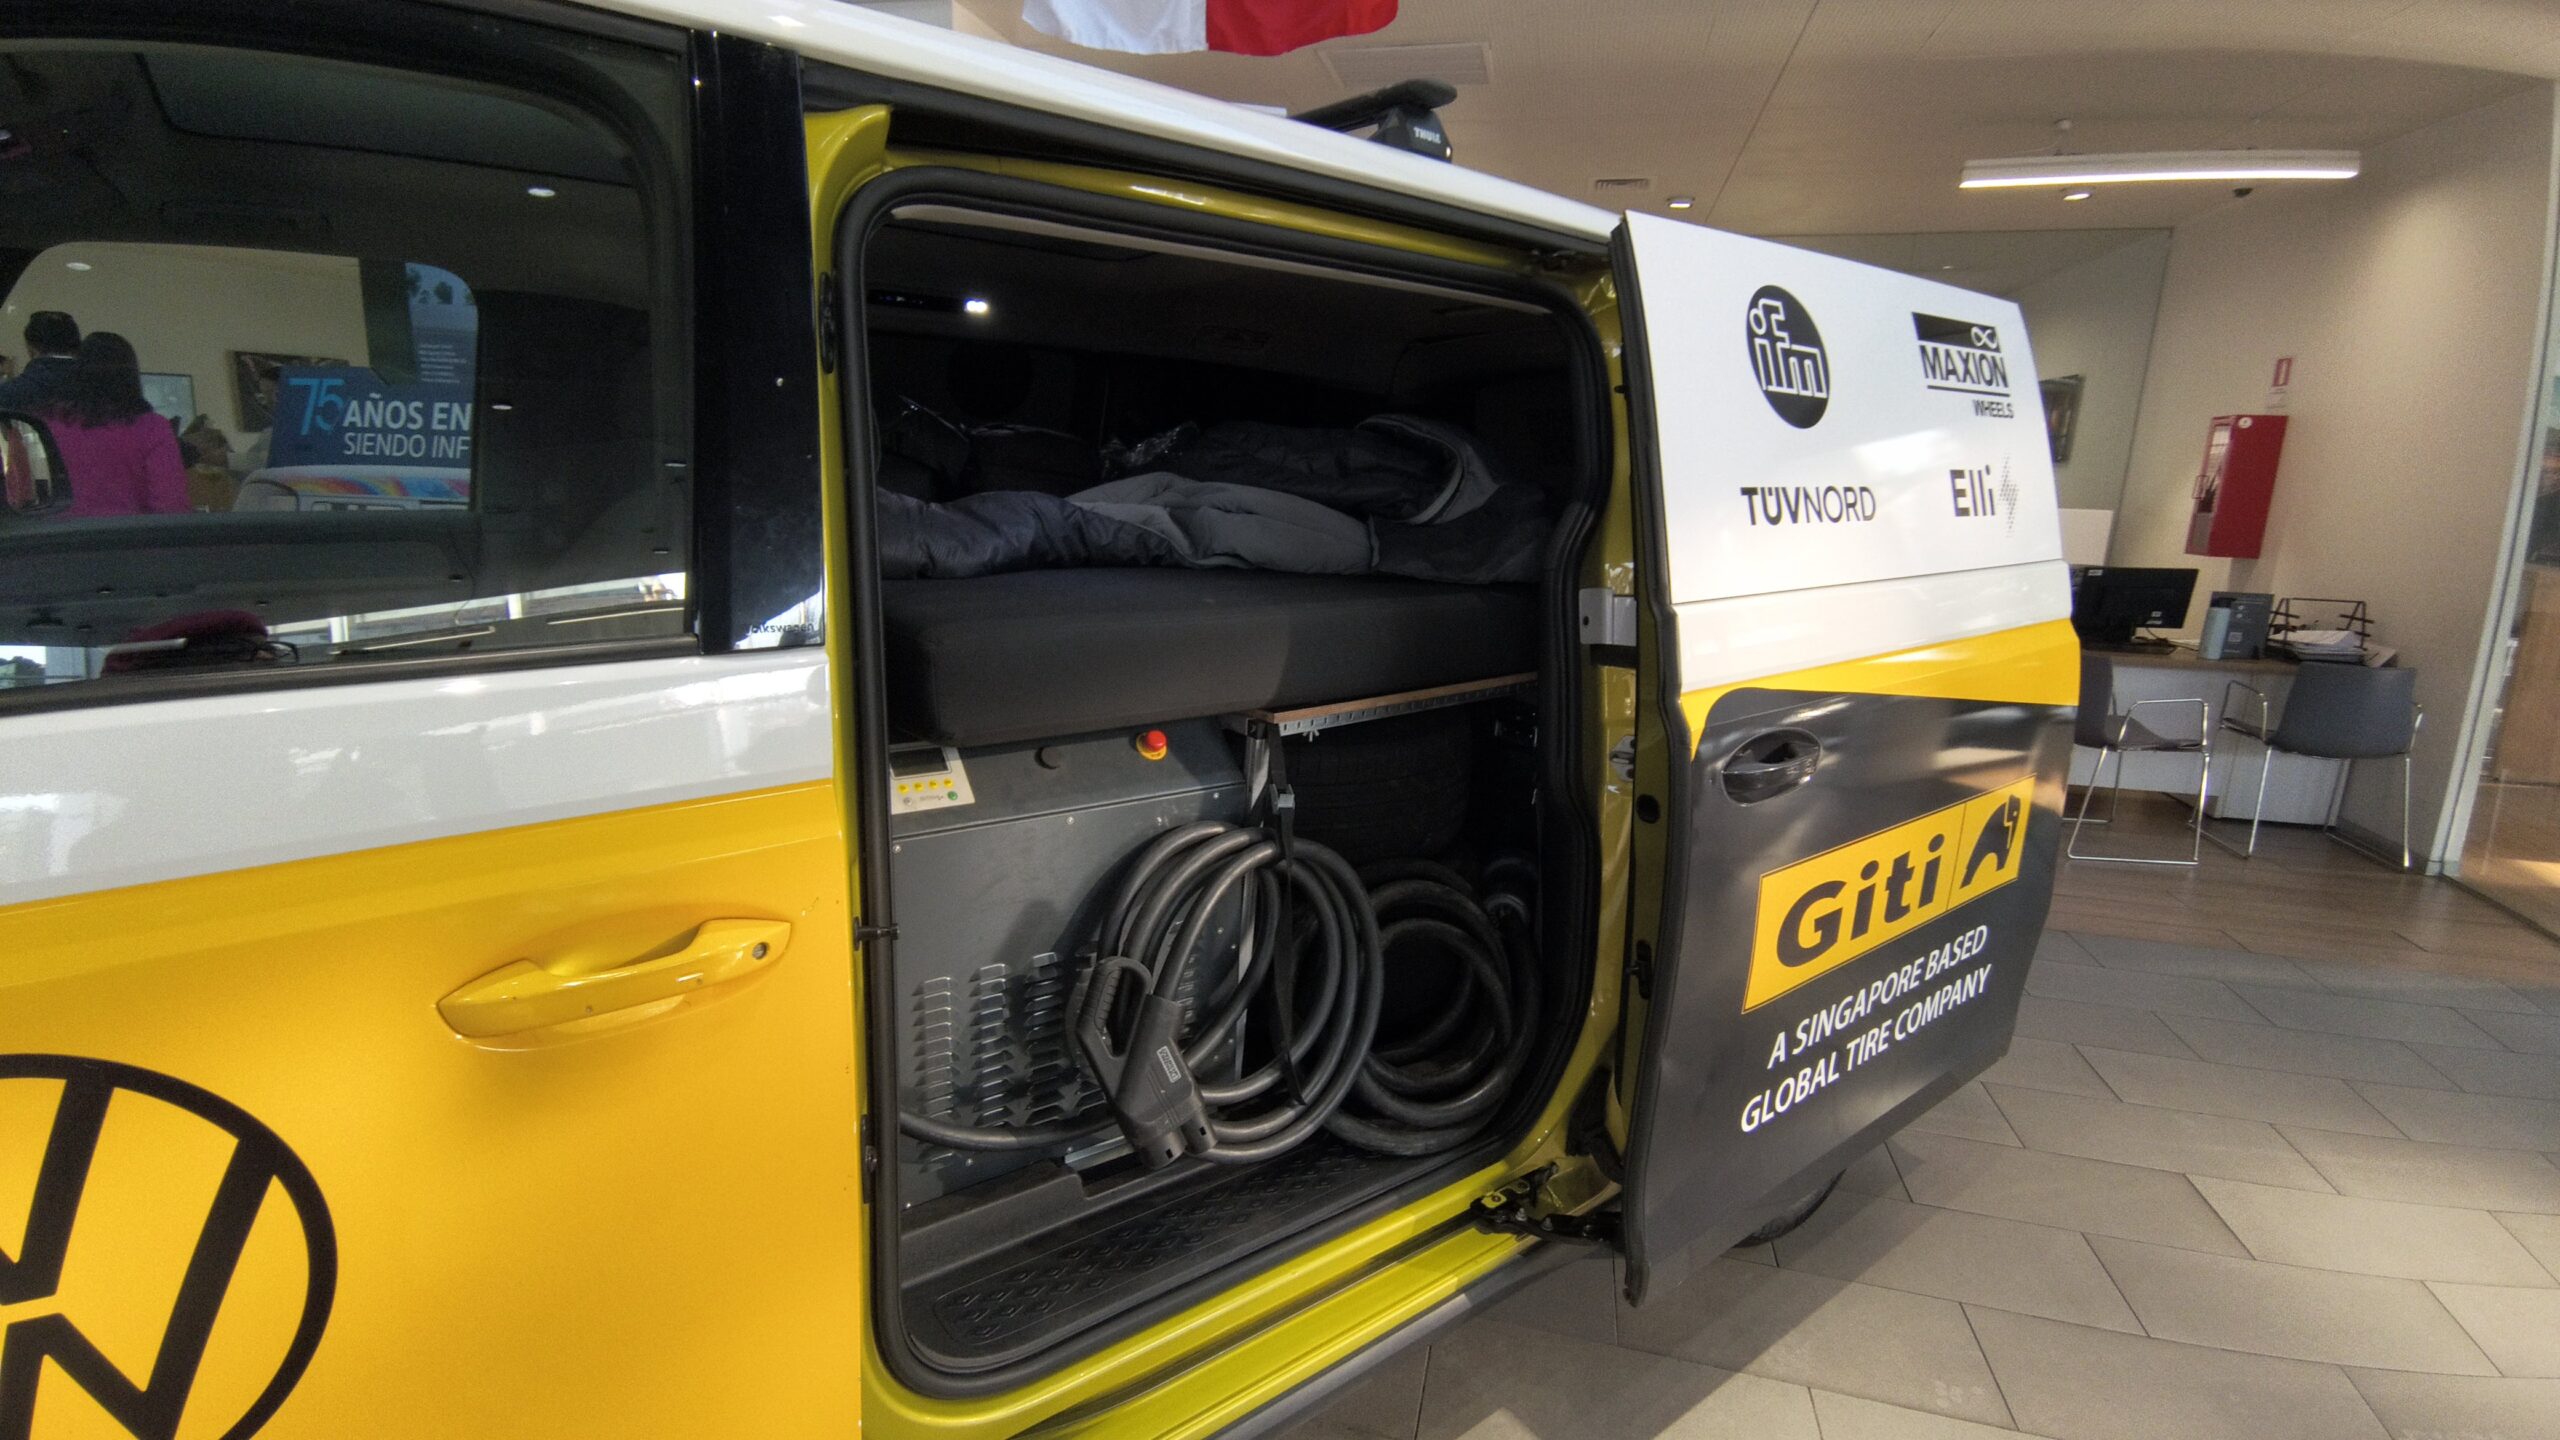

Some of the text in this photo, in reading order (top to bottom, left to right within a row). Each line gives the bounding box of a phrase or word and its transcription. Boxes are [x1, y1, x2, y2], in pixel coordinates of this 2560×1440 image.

[1919, 344, 2009, 388] MAXION
[287, 377, 473, 436] 75 AÑOS EN
[1973, 399, 2014, 418] WHEELS
[343, 432, 472, 459] SIENDO INF
[1949, 464, 1996, 517] Elli
[1776, 833, 1946, 968] Giti
[1767, 925, 1988, 1070] A SINGAPORE BASED
[1740, 964, 1993, 1133] GLOBAL TIRE COMPANY
